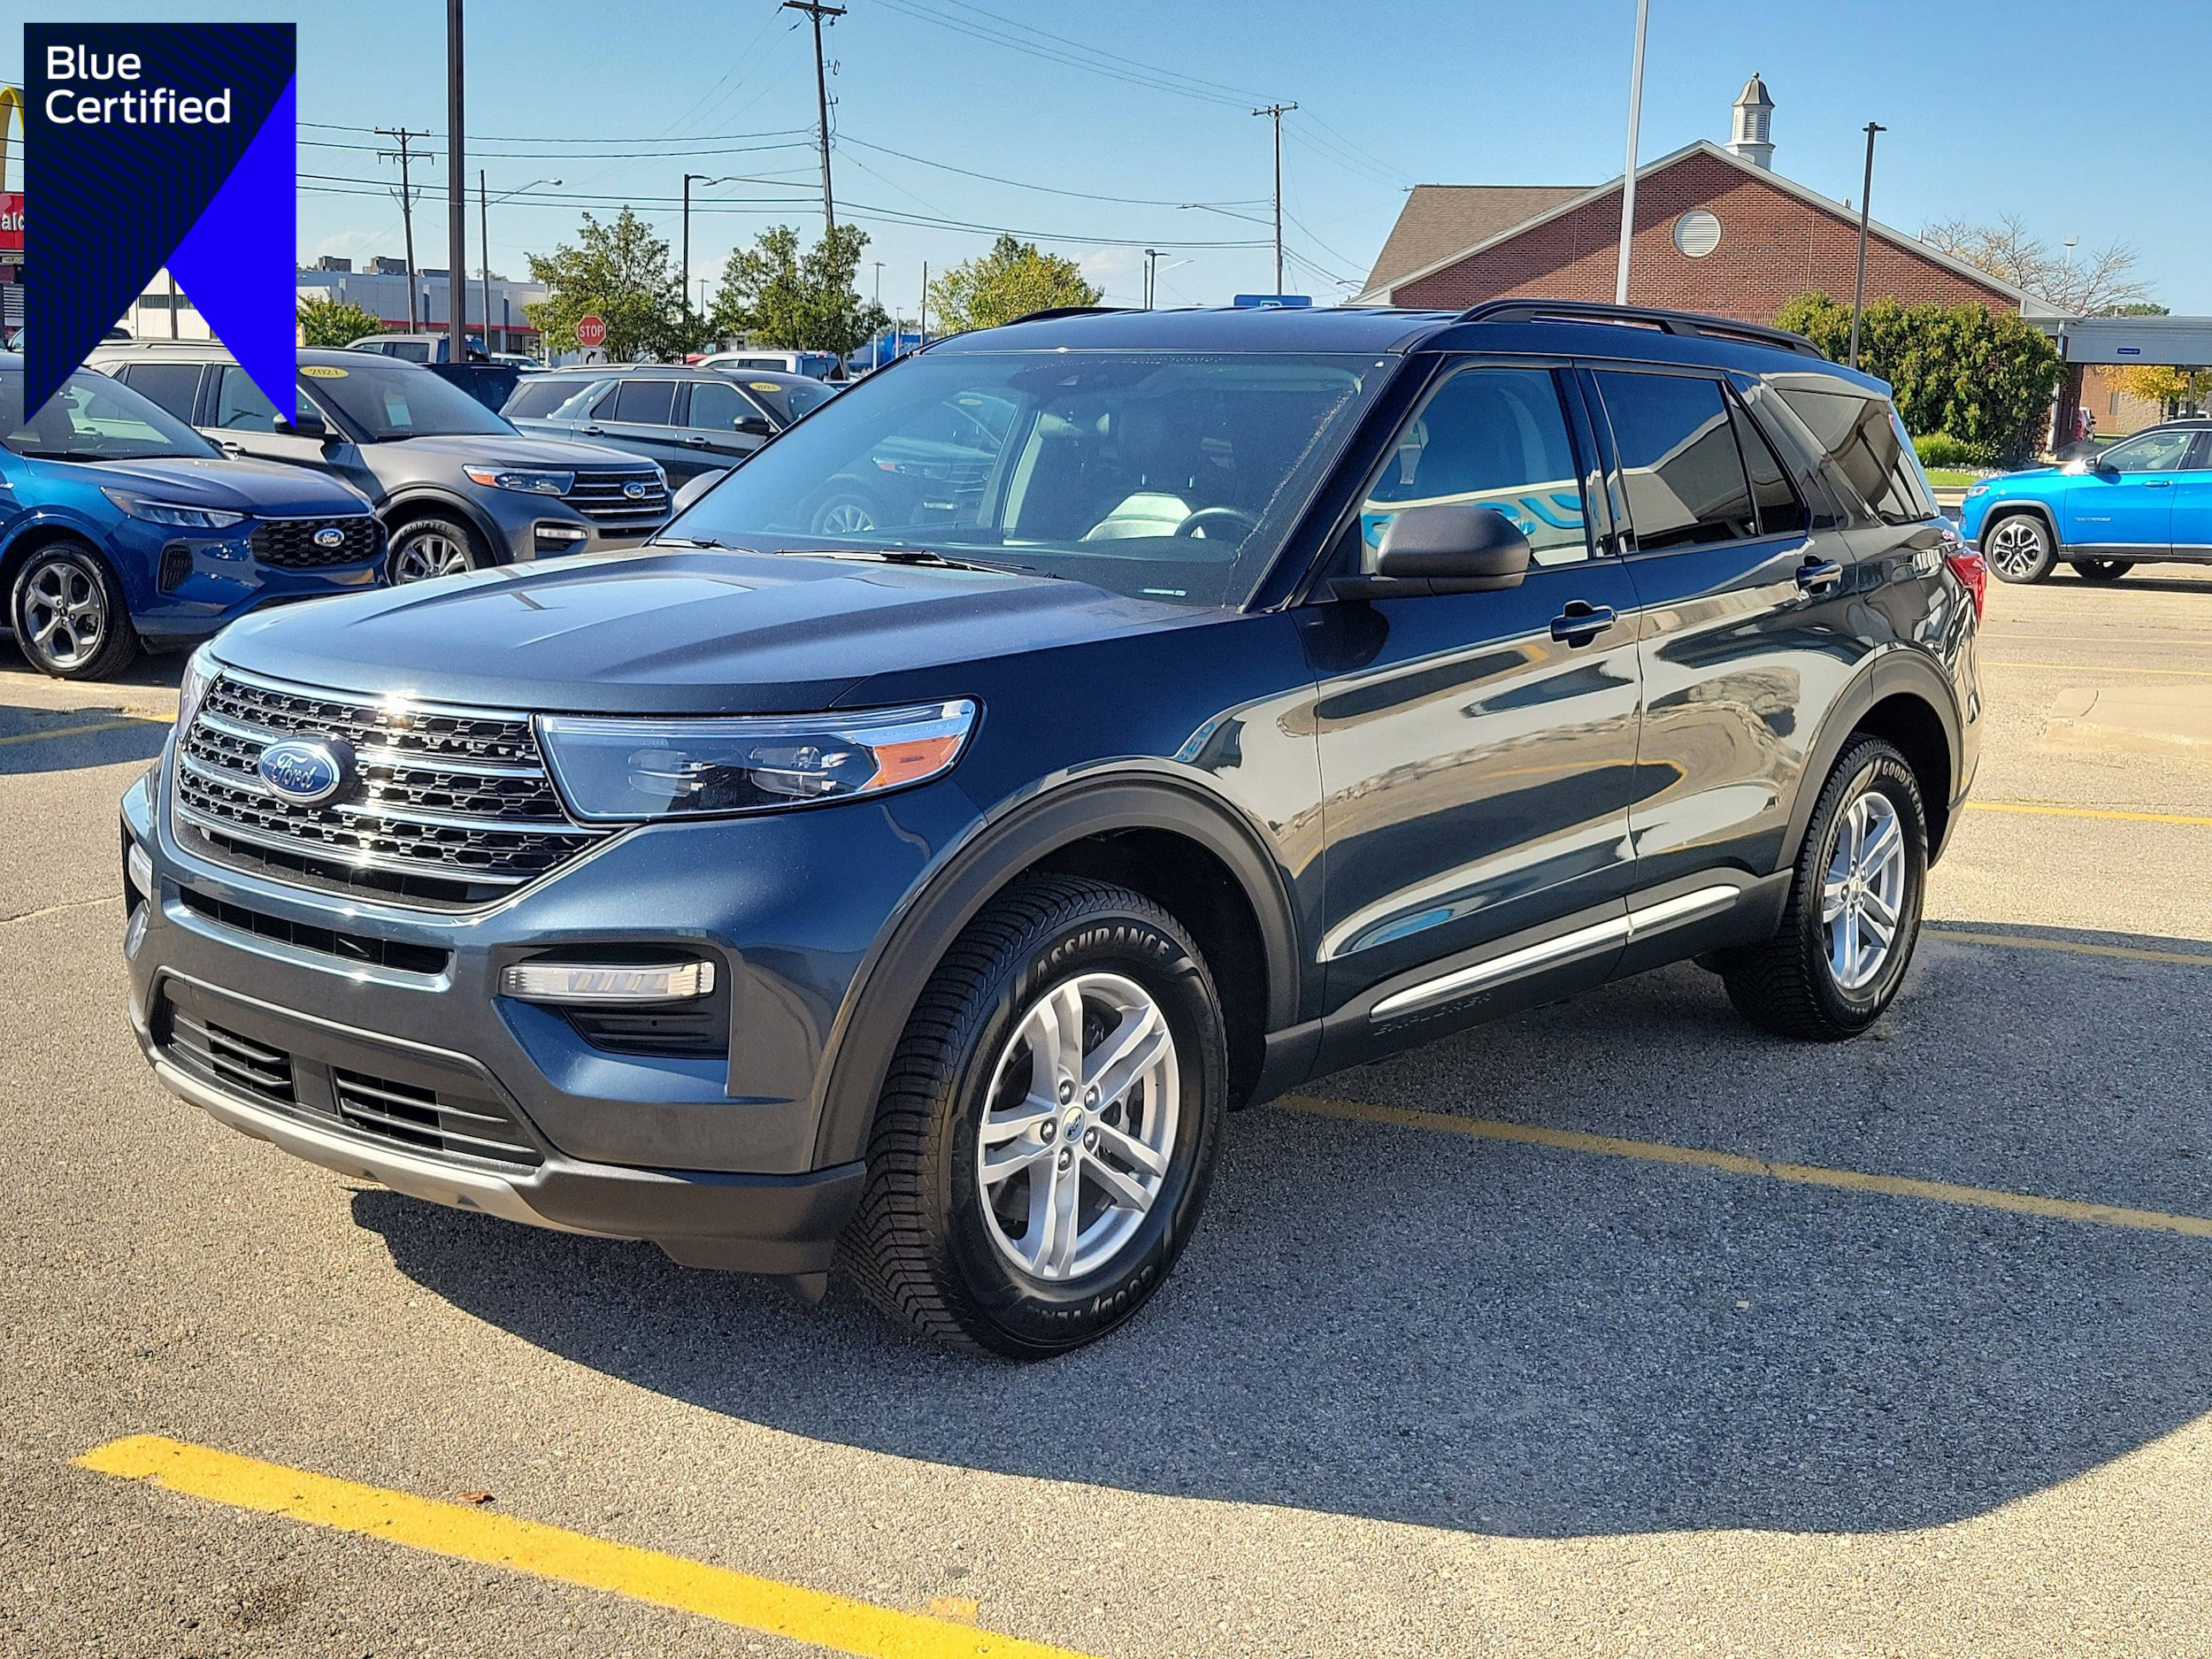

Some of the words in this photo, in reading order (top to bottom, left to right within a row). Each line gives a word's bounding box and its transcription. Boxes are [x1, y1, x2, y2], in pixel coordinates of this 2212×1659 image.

[579, 325, 603, 338] STOP
[267, 752, 318, 789] Ford
[1882, 761, 1925, 827] GOODYEAR
[1036, 926, 1171, 984] ASSURANCE
